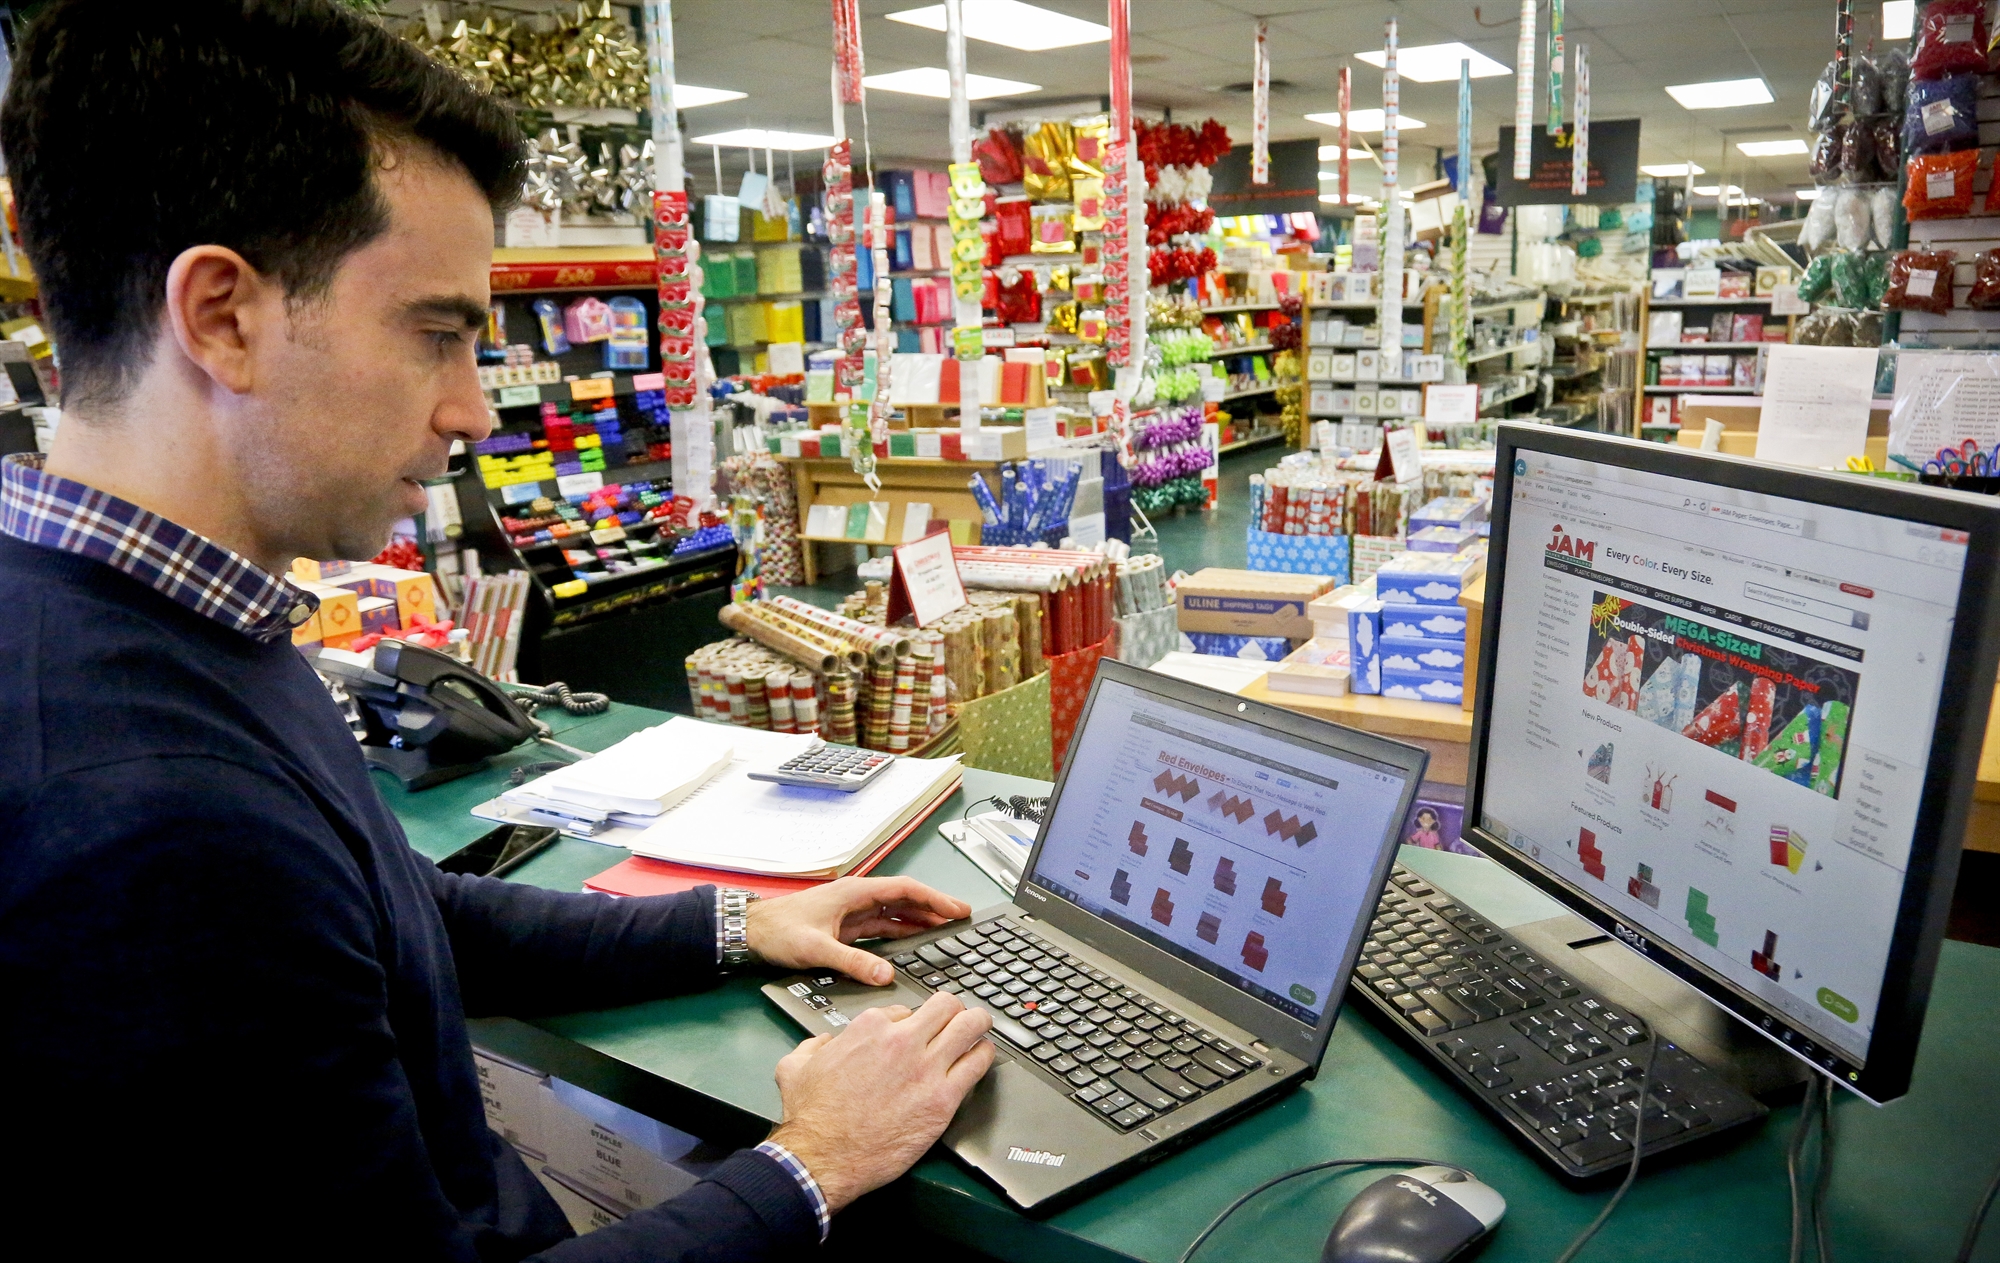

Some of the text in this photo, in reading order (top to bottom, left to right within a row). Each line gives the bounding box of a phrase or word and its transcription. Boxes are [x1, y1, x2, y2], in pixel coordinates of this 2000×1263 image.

[1545, 534, 1596, 562] JAM
[1574, 567, 1614, 584] PLASTIC ENVELOPES
[1606, 547, 1714, 586] Every Color. Every Size.
[1620, 581, 1648, 594] PORTFOLIOS
[1188, 597, 1220, 609] ULINE
[1222, 601, 1254, 610] SHIPPING
[1593, 596, 1622, 619] NEW!
[1654, 591, 1693, 608] OFFICE SUPPLIES
[1700, 604, 1717, 615] PAPER
[1724, 612, 1743, 623] CARDS
[1750, 619, 1796, 639] GIFT PACKAGING
[1613, 616, 1675, 645] Double-Sided
[1664, 615, 1763, 660] MEGA-Sized
[1804, 636, 1822, 647] SHOP
[1830, 643, 1861, 659] PURPOSE
[1675, 636, 1822, 694] Christmas Wrapping Paper
[1582, 709, 1622, 733] New Products
[1158, 750, 1176, 765] Red
[1177, 757, 1226, 783] Envelopes
[1571, 801, 1622, 835] Featured Products
[1024, 886, 1047, 902] lenovo
[1615, 922, 1648, 954] DELL
[590, 1129, 623, 1149] STAPLES
[596, 1149, 622, 1169] BLUE
[1007, 1147, 1066, 1167] ThinkPad
[1396, 1181, 1438, 1207] DELL
